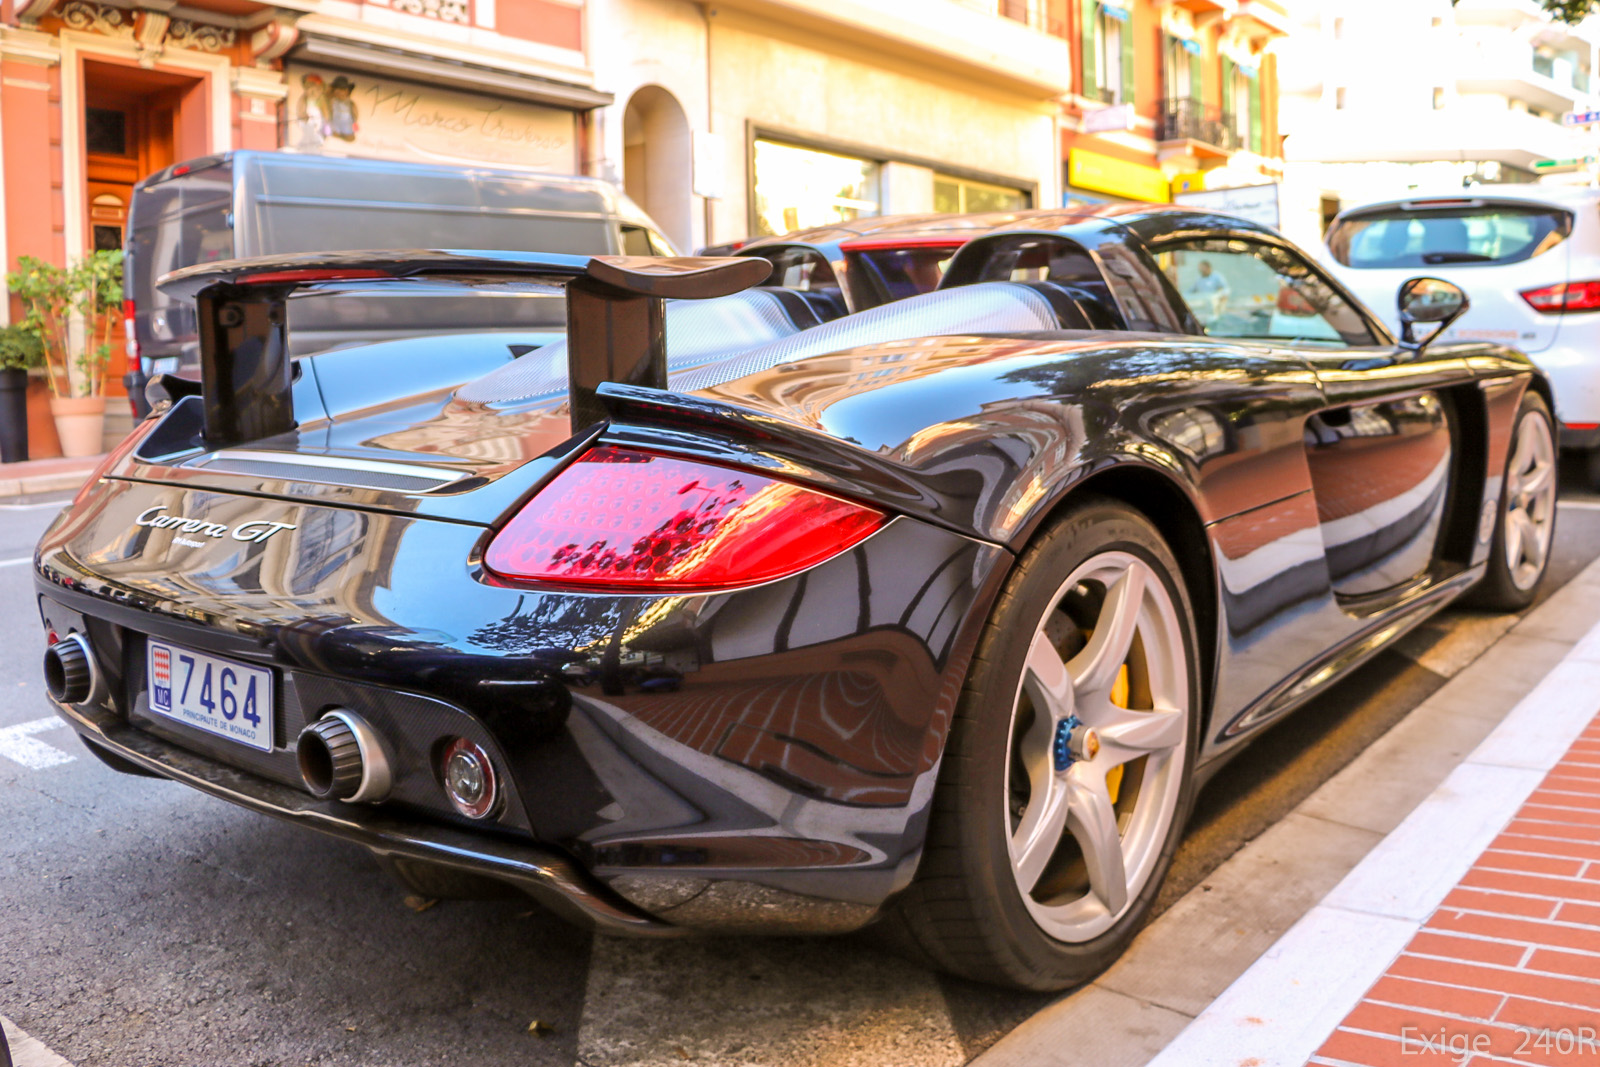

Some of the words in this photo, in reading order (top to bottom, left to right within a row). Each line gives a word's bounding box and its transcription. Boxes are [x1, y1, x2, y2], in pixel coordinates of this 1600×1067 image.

[365, 84, 474, 133] Marco
[135, 505, 228, 538] Carrera
[231, 520, 297, 543] GT
[157, 688, 169, 706] MC
[179, 654, 261, 728] 7464
[182, 708, 218, 728] PRINCIPAUTE
[219, 720, 228, 731] DE
[229, 723, 256, 740] MONACO
